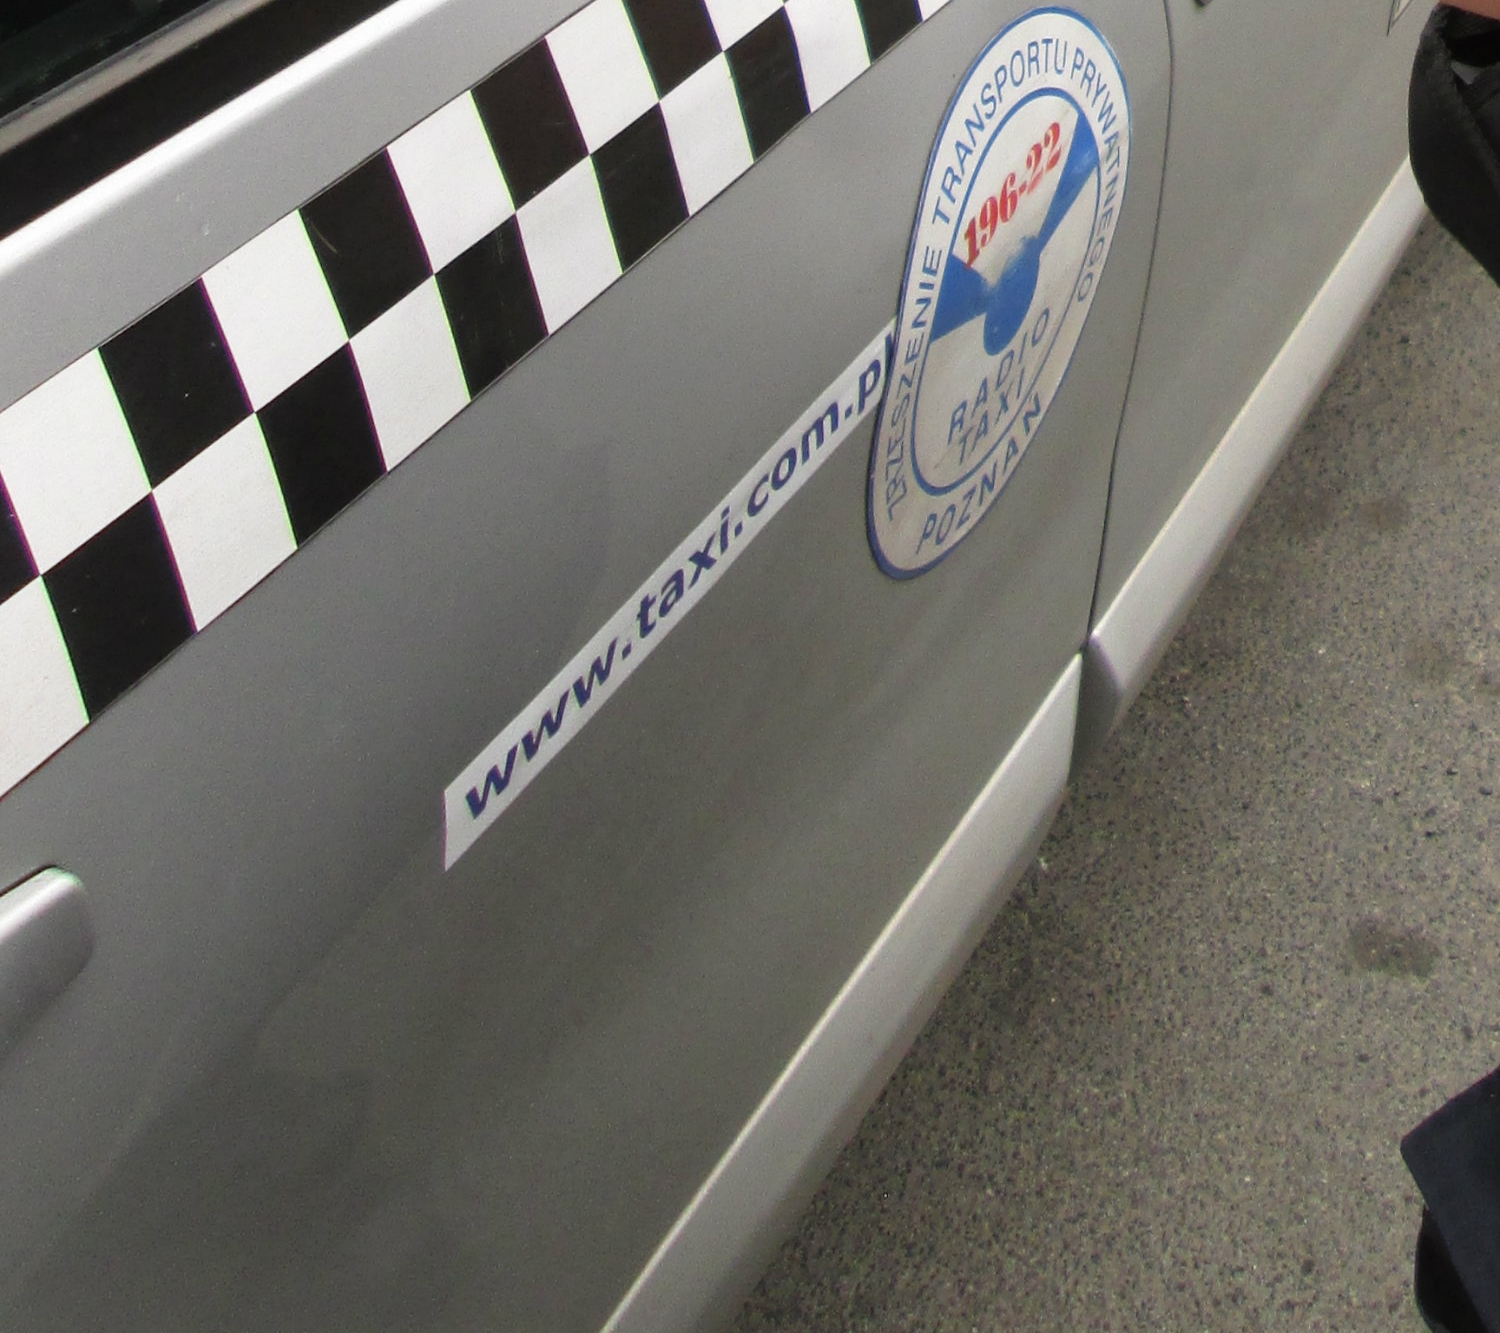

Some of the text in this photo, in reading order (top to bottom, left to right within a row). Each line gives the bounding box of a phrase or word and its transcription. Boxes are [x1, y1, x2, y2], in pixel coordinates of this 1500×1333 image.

[931, 37, 1069, 226] TRANSPORTU
[1070, 46, 1122, 304] PRYWATNEGO
[963, 121, 1063, 270] 196-22
[947, 307, 1051, 447] RADIO
[957, 366, 1027, 467] TAXI
[915, 391, 1043, 556] POZNAŃ
